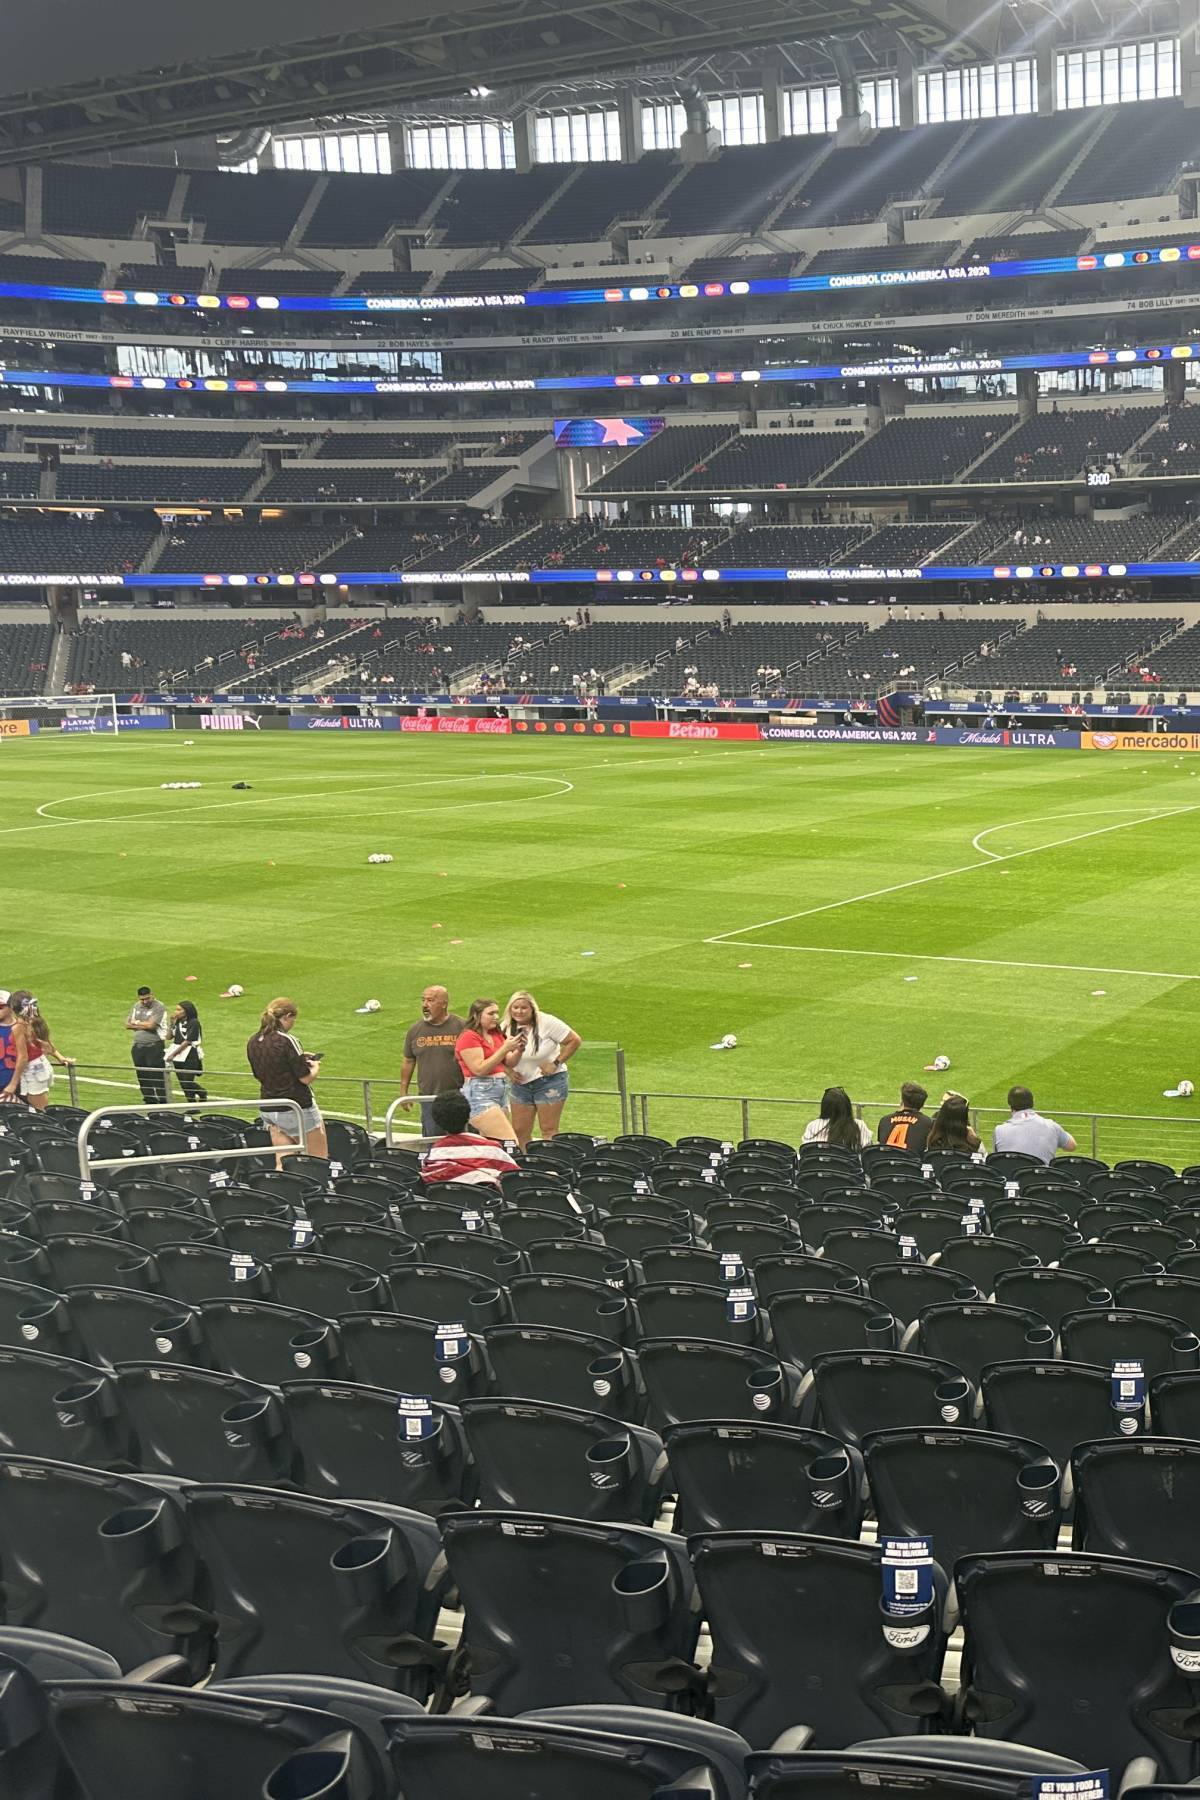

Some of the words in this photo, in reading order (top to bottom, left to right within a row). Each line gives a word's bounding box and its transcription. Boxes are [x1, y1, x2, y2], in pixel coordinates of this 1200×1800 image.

[830, 273, 880, 287] CONMEBOL
[881, 271, 906, 285] COPA
[904, 270, 947, 282] AMERICA
[949, 267, 966, 278] USA
[968, 265, 990, 277] 2024
[367, 299, 420, 310] CONMEBOL
[420, 298, 446, 309] COPA
[445, 297, 484, 308] AMERICA
[485, 296, 503, 306] USA
[504, 295, 526, 305] 2024
[1138, 301, 1155, 309] BOB
[1155, 298, 1174, 307] LILLY
[975, 313, 990, 321] DON
[992, 310, 1026, 319] MEREDITH
[823, 322, 844, 330] CHUCK
[3, 328, 46, 338] RAYFIELD
[48, 330, 83, 340] WRIGHT
[556, 335, 578, 343] WHITE
[239, 340, 269, 348] HARRIS
[841, 364, 892, 377] CONMEBOL
[892, 363, 919, 375] COPA
[917, 361, 959, 373] AMERICA
[961, 360, 978, 370] USA
[979, 358, 1002, 370] 2024
[376, 381, 429, 392] CONMEBOL
[429, 381, 457, 392] COPA
[456, 380, 494, 391] AMERICA
[496, 379, 513, 390] USA
[513, 379, 535, 389] 2024
[1088, 473, 1110, 486] 30:00
[201, 715, 243, 730] PUMA
[308, 718, 341, 730] Michelob
[350, 718, 381, 729] ULTRA
[669, 723, 718, 738] Betano
[769, 728, 816, 739] CONMEBOL
[817, 729, 843, 739] COPA
[842, 730, 881, 740] AMERICA
[882, 731, 900, 741] USA
[959, 732, 1001, 744] Michelob
[1013, 733, 1056, 745] ULTRA
[1122, 735, 1188, 748] mercado
[886, 1123, 910, 1149] 4
[887, 1631, 921, 1645] Ford
[1041, 1781, 1055, 1793] GET
[1056, 1781, 1075, 1793] YOUR
[1075, 1780, 1094, 1791] FOOD
